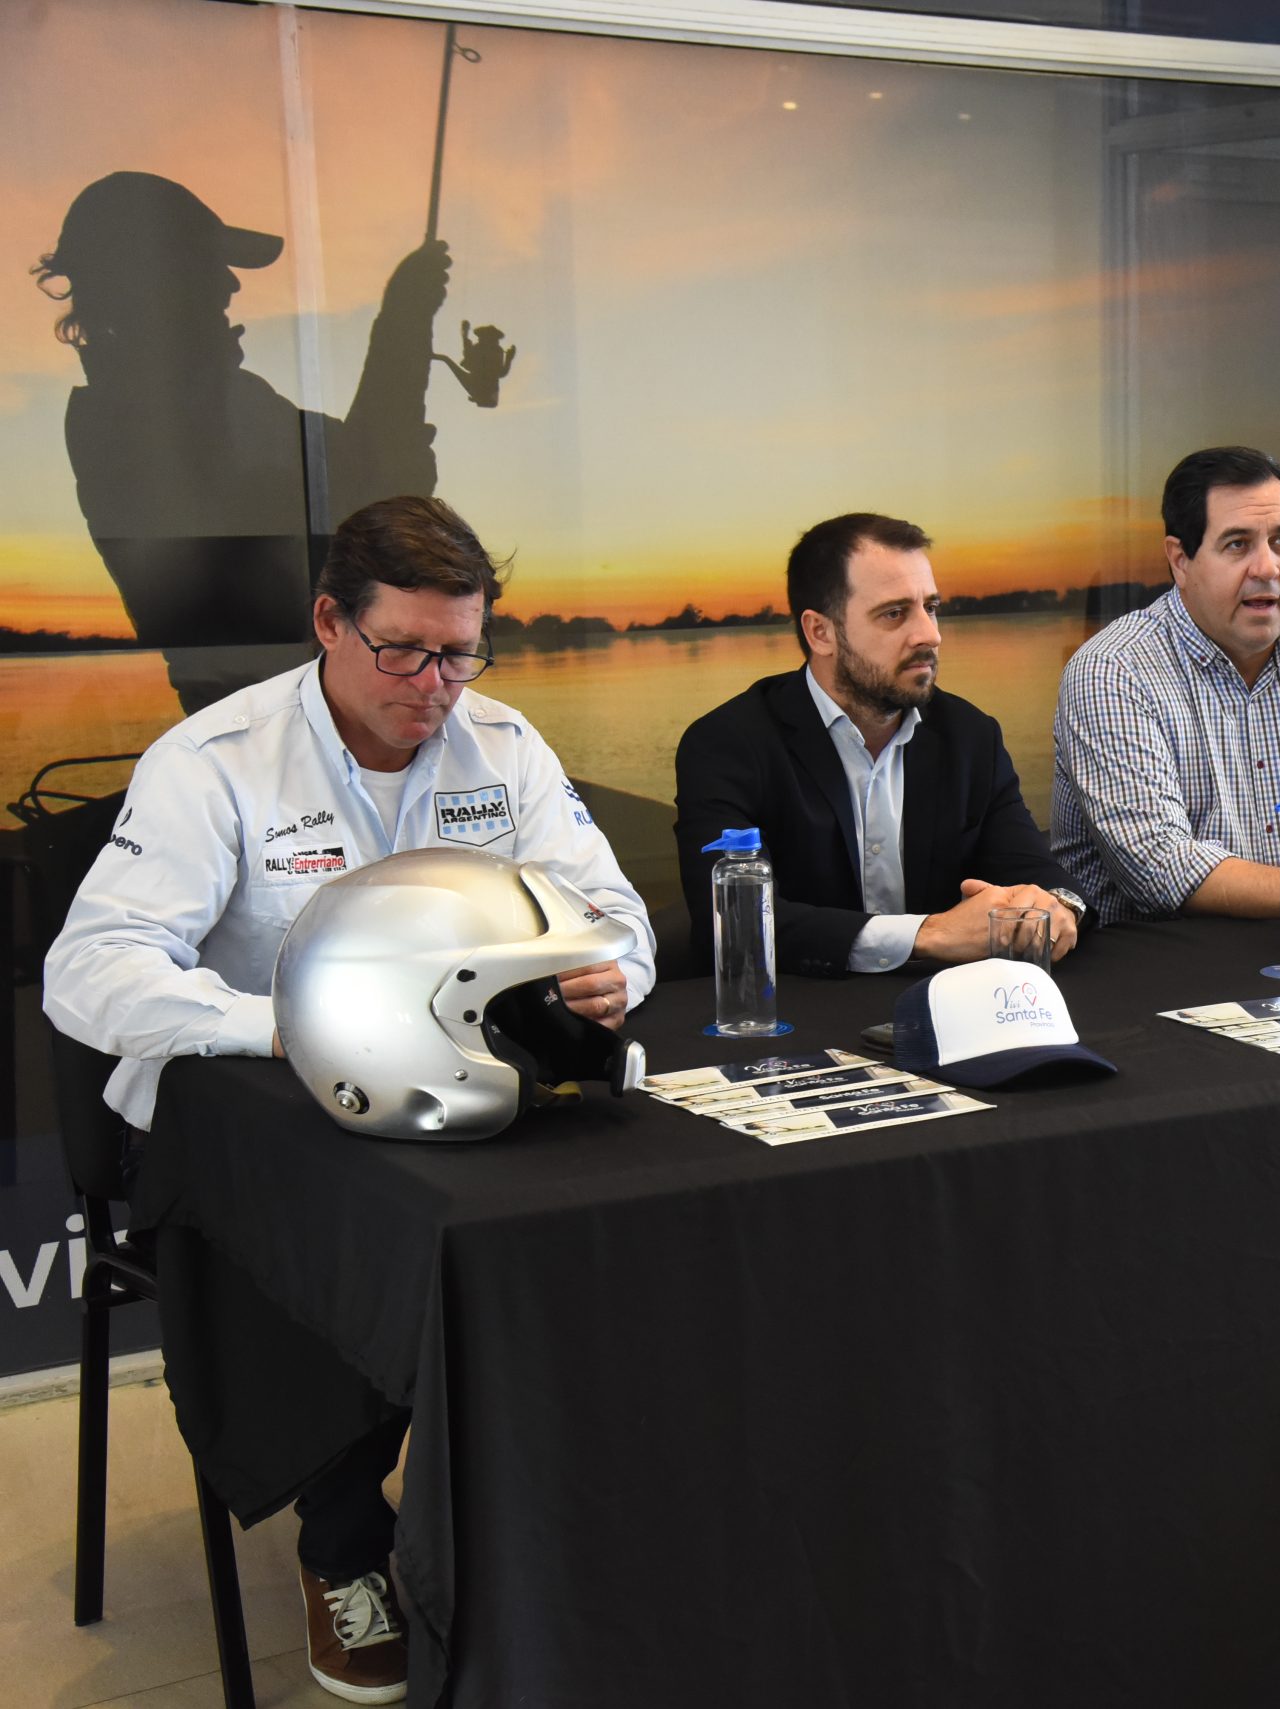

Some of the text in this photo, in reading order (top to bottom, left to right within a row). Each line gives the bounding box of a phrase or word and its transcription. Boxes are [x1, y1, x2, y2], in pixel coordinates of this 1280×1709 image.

[440, 801, 503, 818] RALLY
[443, 811, 507, 824] ARGENTINO
[301, 810, 334, 830] Rally
[265, 857, 293, 872] RALLY
[996, 1007, 1053, 1024] Santa Fe
